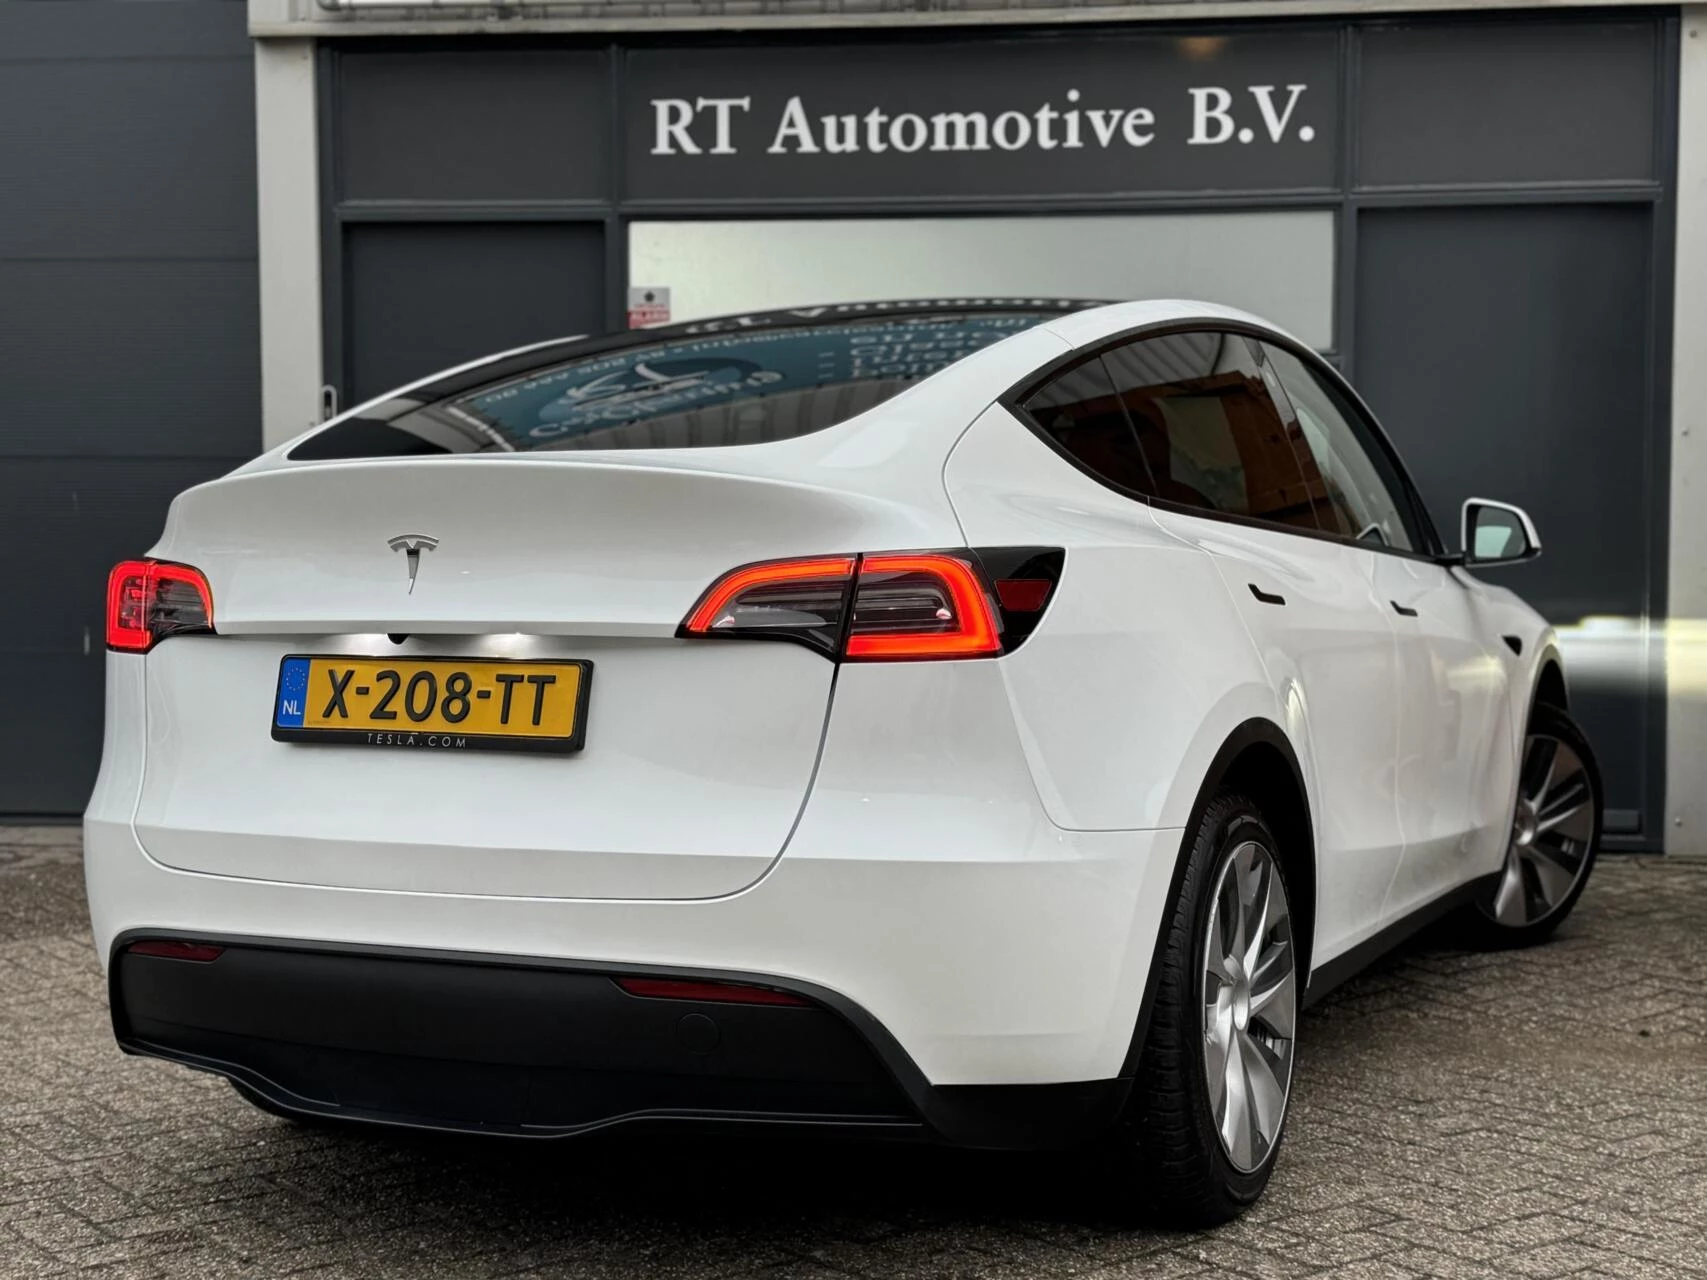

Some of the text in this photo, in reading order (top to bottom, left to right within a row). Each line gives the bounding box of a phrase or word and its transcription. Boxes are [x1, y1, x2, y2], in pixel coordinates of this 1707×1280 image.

[650, 84, 1315, 154] RT Automotive B.V.
[282, 699, 302, 716] NL
[322, 668, 557, 726] X-208-TT
[367, 732, 467, 749] TESLA.COM
